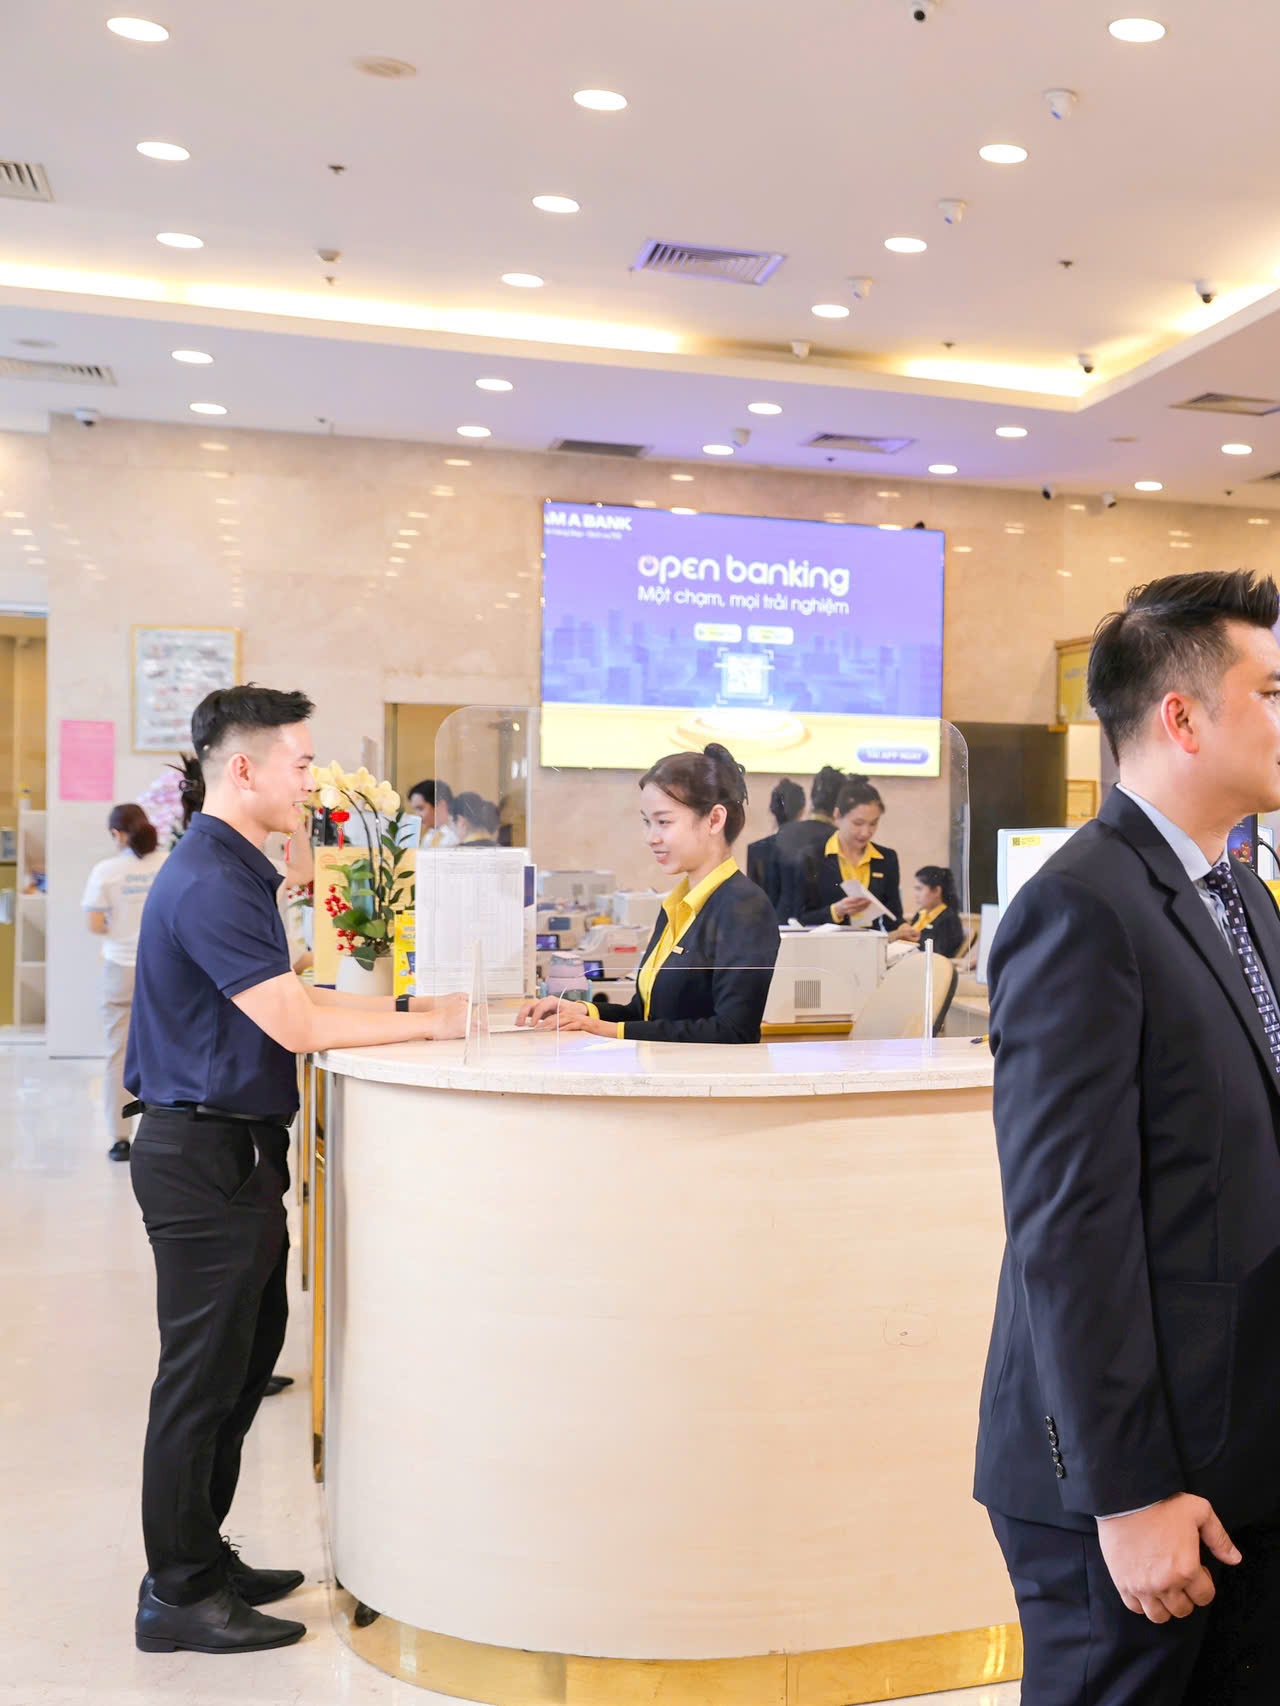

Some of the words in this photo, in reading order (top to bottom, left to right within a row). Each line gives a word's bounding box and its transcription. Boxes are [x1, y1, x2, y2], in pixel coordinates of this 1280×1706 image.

[568, 512, 582, 528] A
[583, 513, 633, 532] BANK
[637, 554, 720, 585] open
[726, 554, 850, 597] banking
[637, 585, 671, 605] Một
[673, 587, 726, 608] chạm,
[729, 591, 761, 613] mọi
[763, 591, 788, 612] trải
[791, 593, 850, 616] nghiệm
